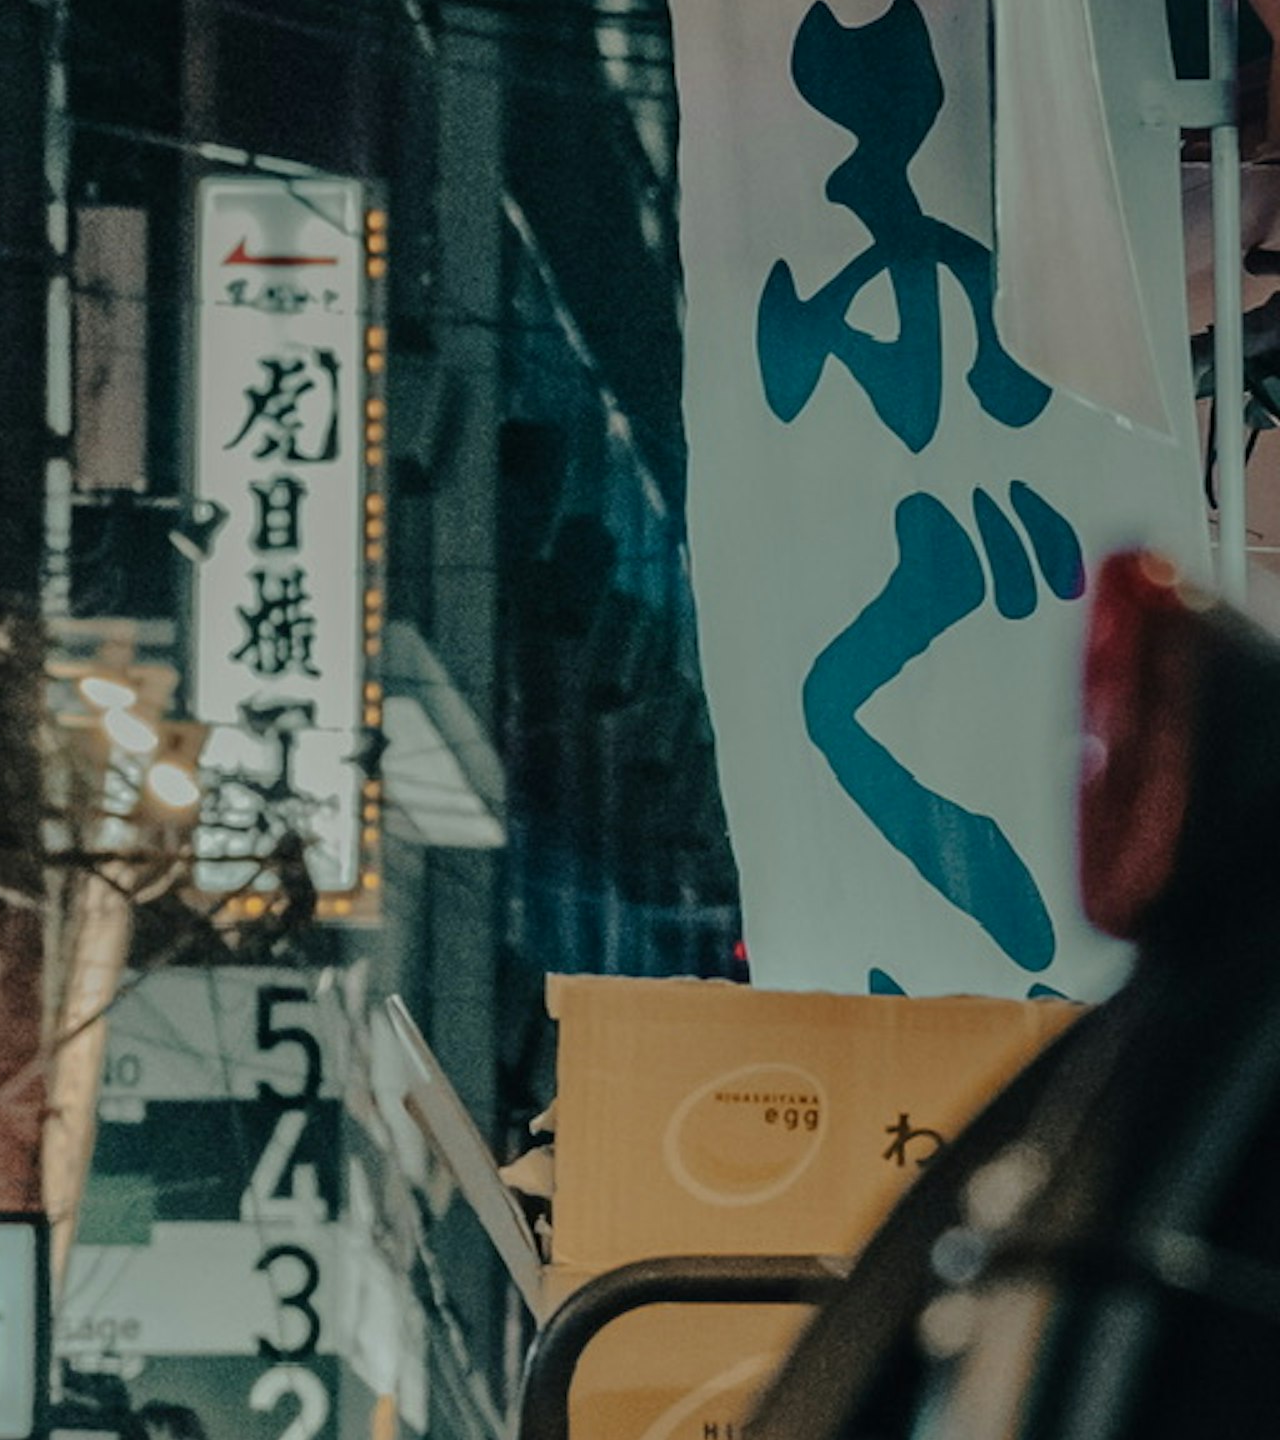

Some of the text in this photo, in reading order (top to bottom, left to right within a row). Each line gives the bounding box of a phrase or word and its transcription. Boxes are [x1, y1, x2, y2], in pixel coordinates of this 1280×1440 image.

[223, 344, 341, 800] 虎目横丁
[255, 986, 322, 1110] 5
[240, 1110, 329, 1221] 4
[763, 1106, 820, 1131] egg
[255, 1243, 321, 1363] 3
